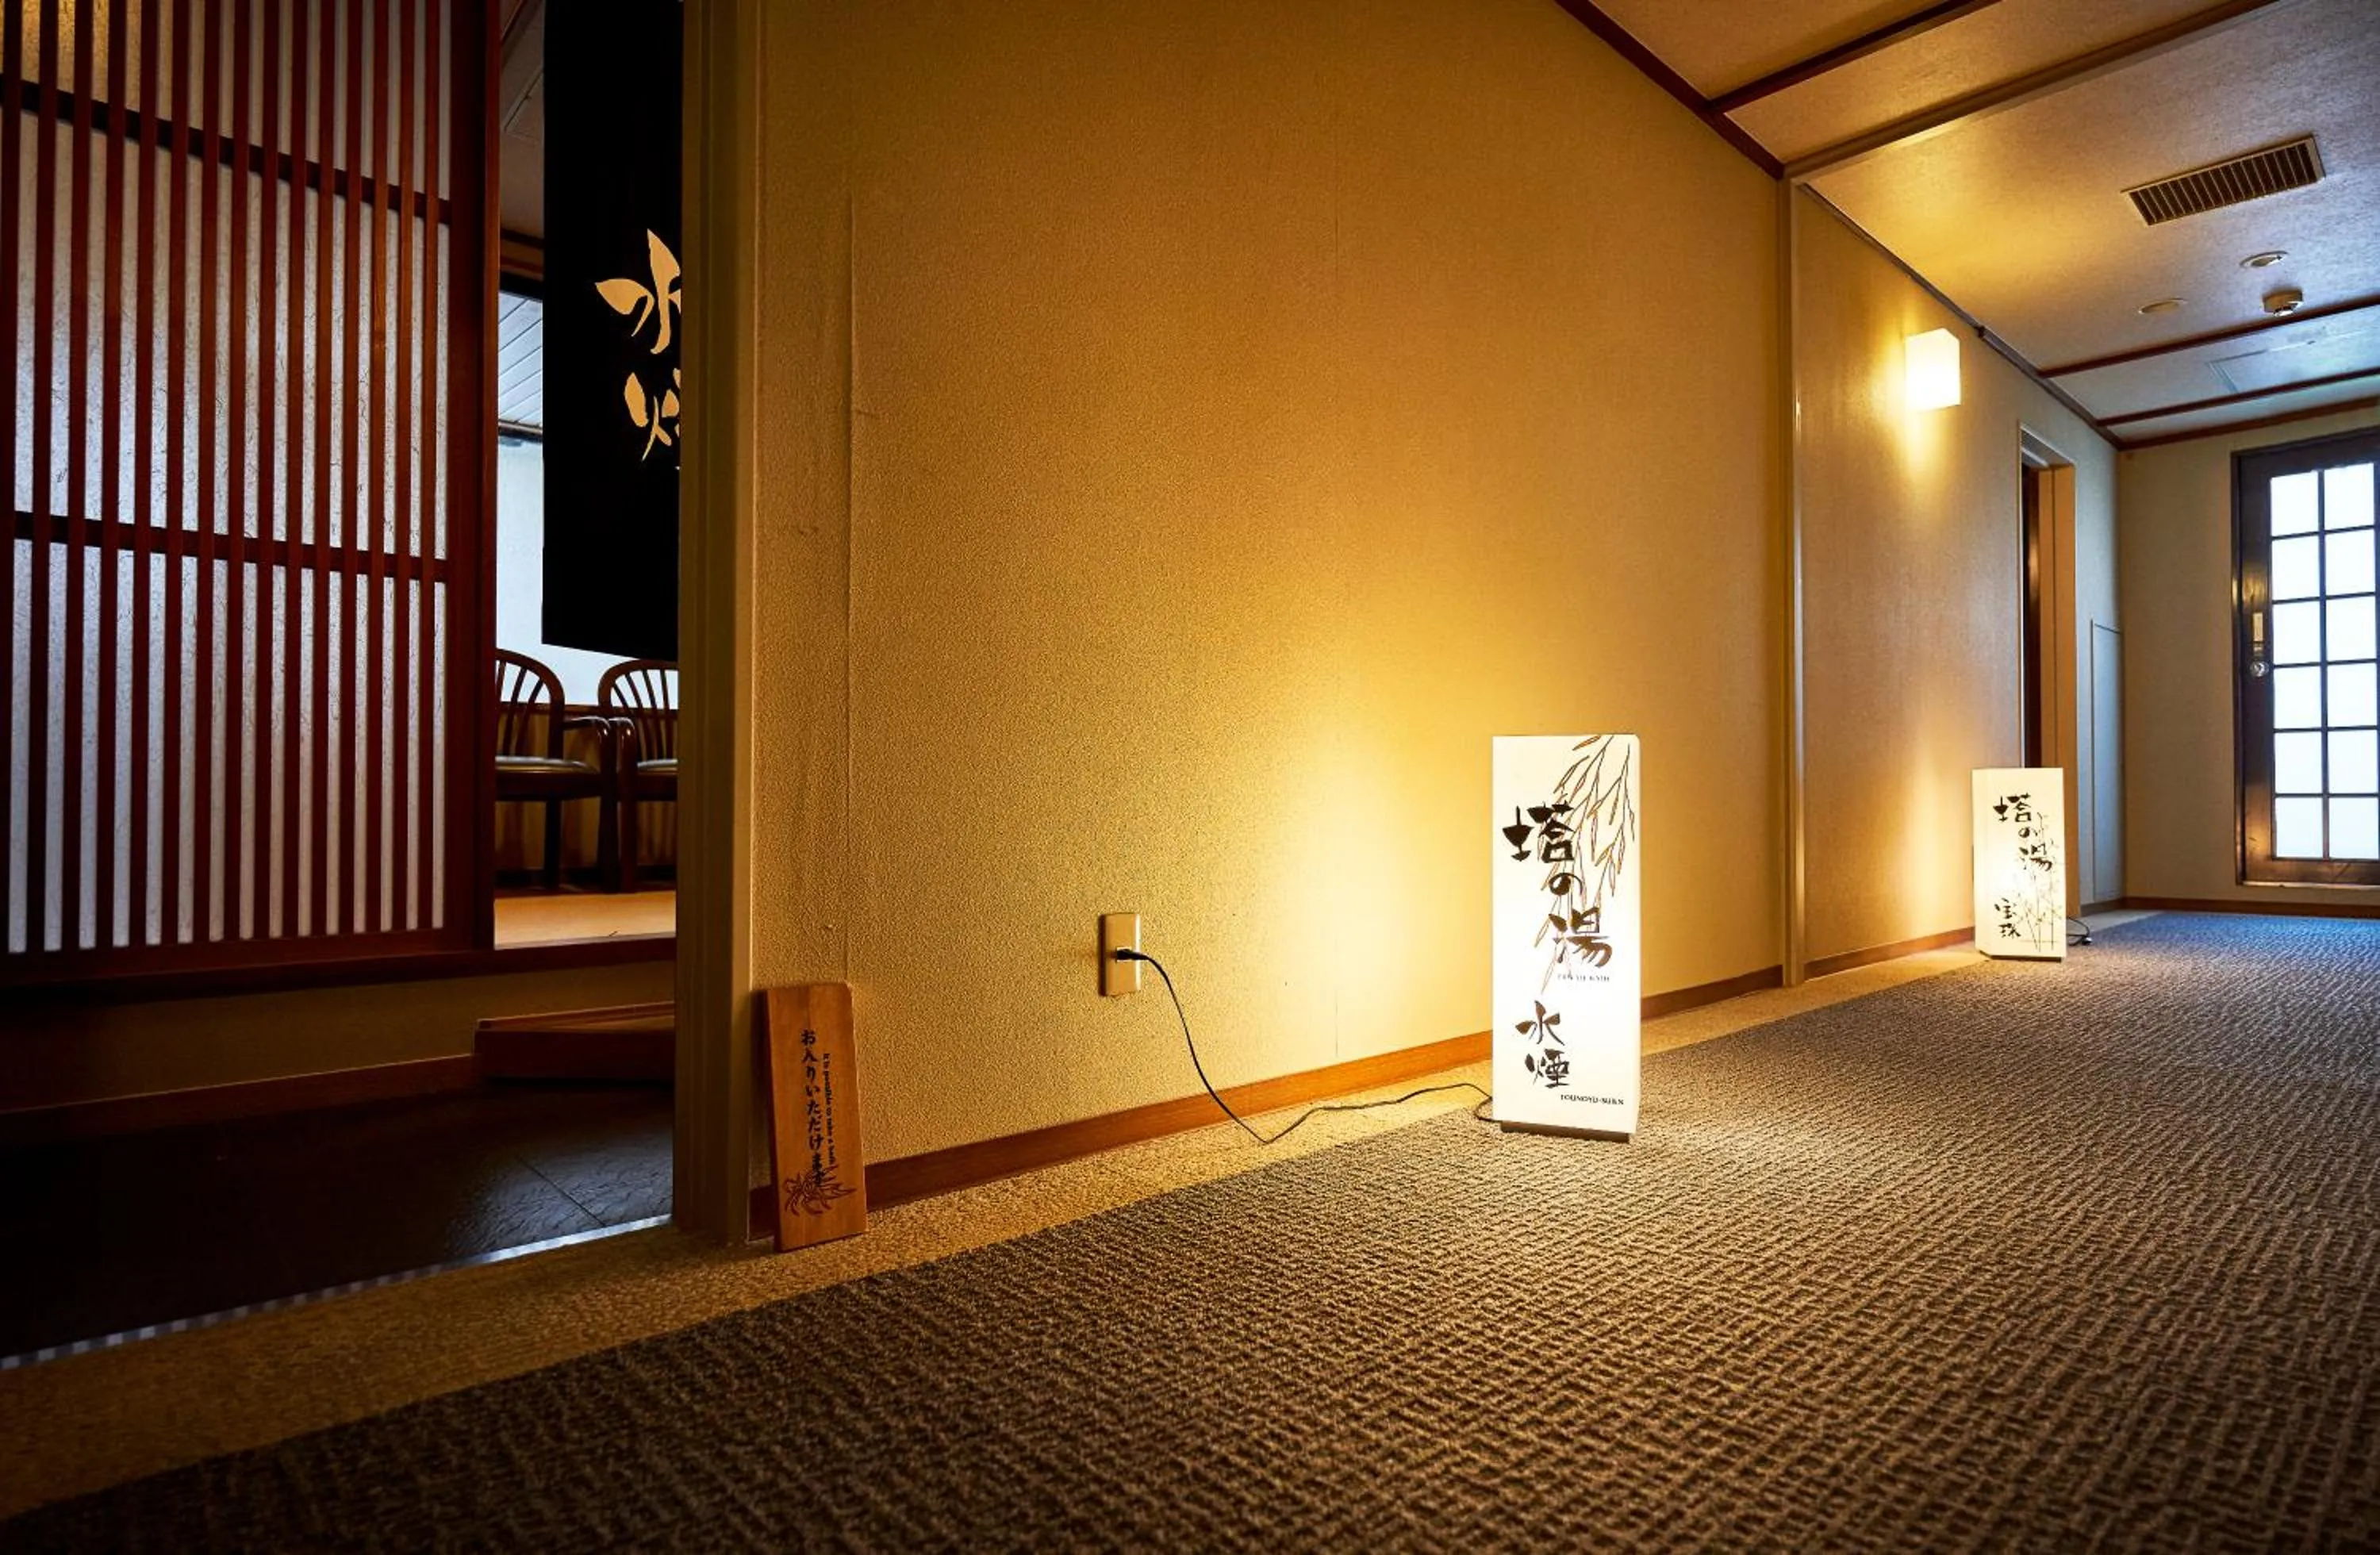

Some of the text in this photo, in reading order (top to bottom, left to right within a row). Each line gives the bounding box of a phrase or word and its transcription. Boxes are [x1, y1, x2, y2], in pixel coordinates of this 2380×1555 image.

[1993, 793, 2053, 871] 塔の湯
[1503, 800, 1614, 969] 塔の湯
[1515, 1000, 1570, 1089] 水煙
